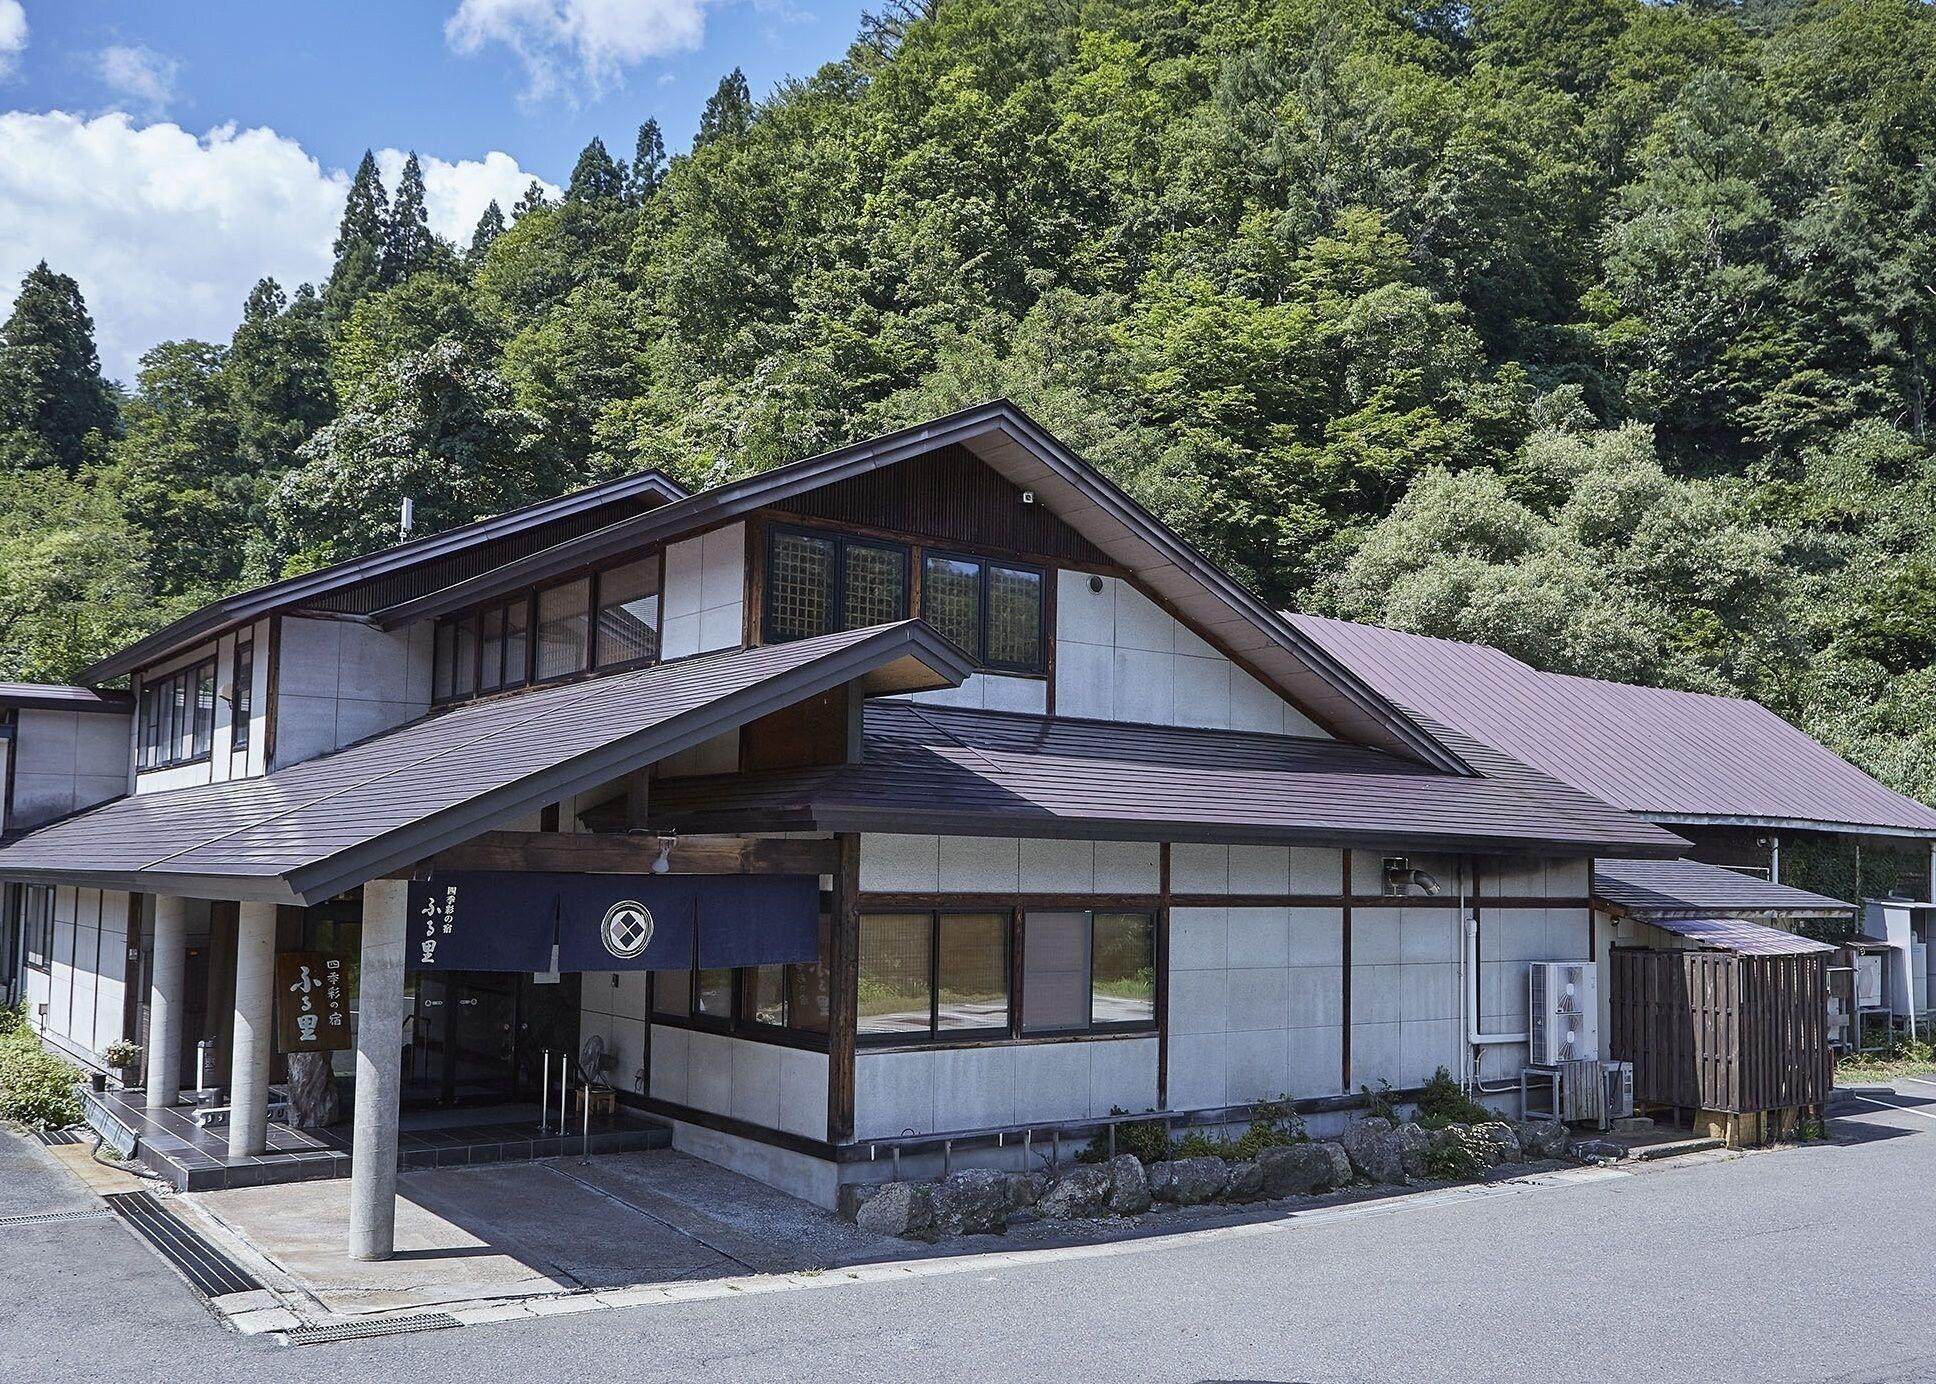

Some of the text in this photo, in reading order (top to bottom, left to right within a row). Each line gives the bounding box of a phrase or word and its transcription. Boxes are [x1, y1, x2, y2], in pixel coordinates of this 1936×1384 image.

[421, 897, 442, 963] ふる里
[443, 886, 457, 934] 四季彩の宿
[289, 965, 322, 1041] ふる里
[326, 959, 342, 1026] 四季彩の宿
